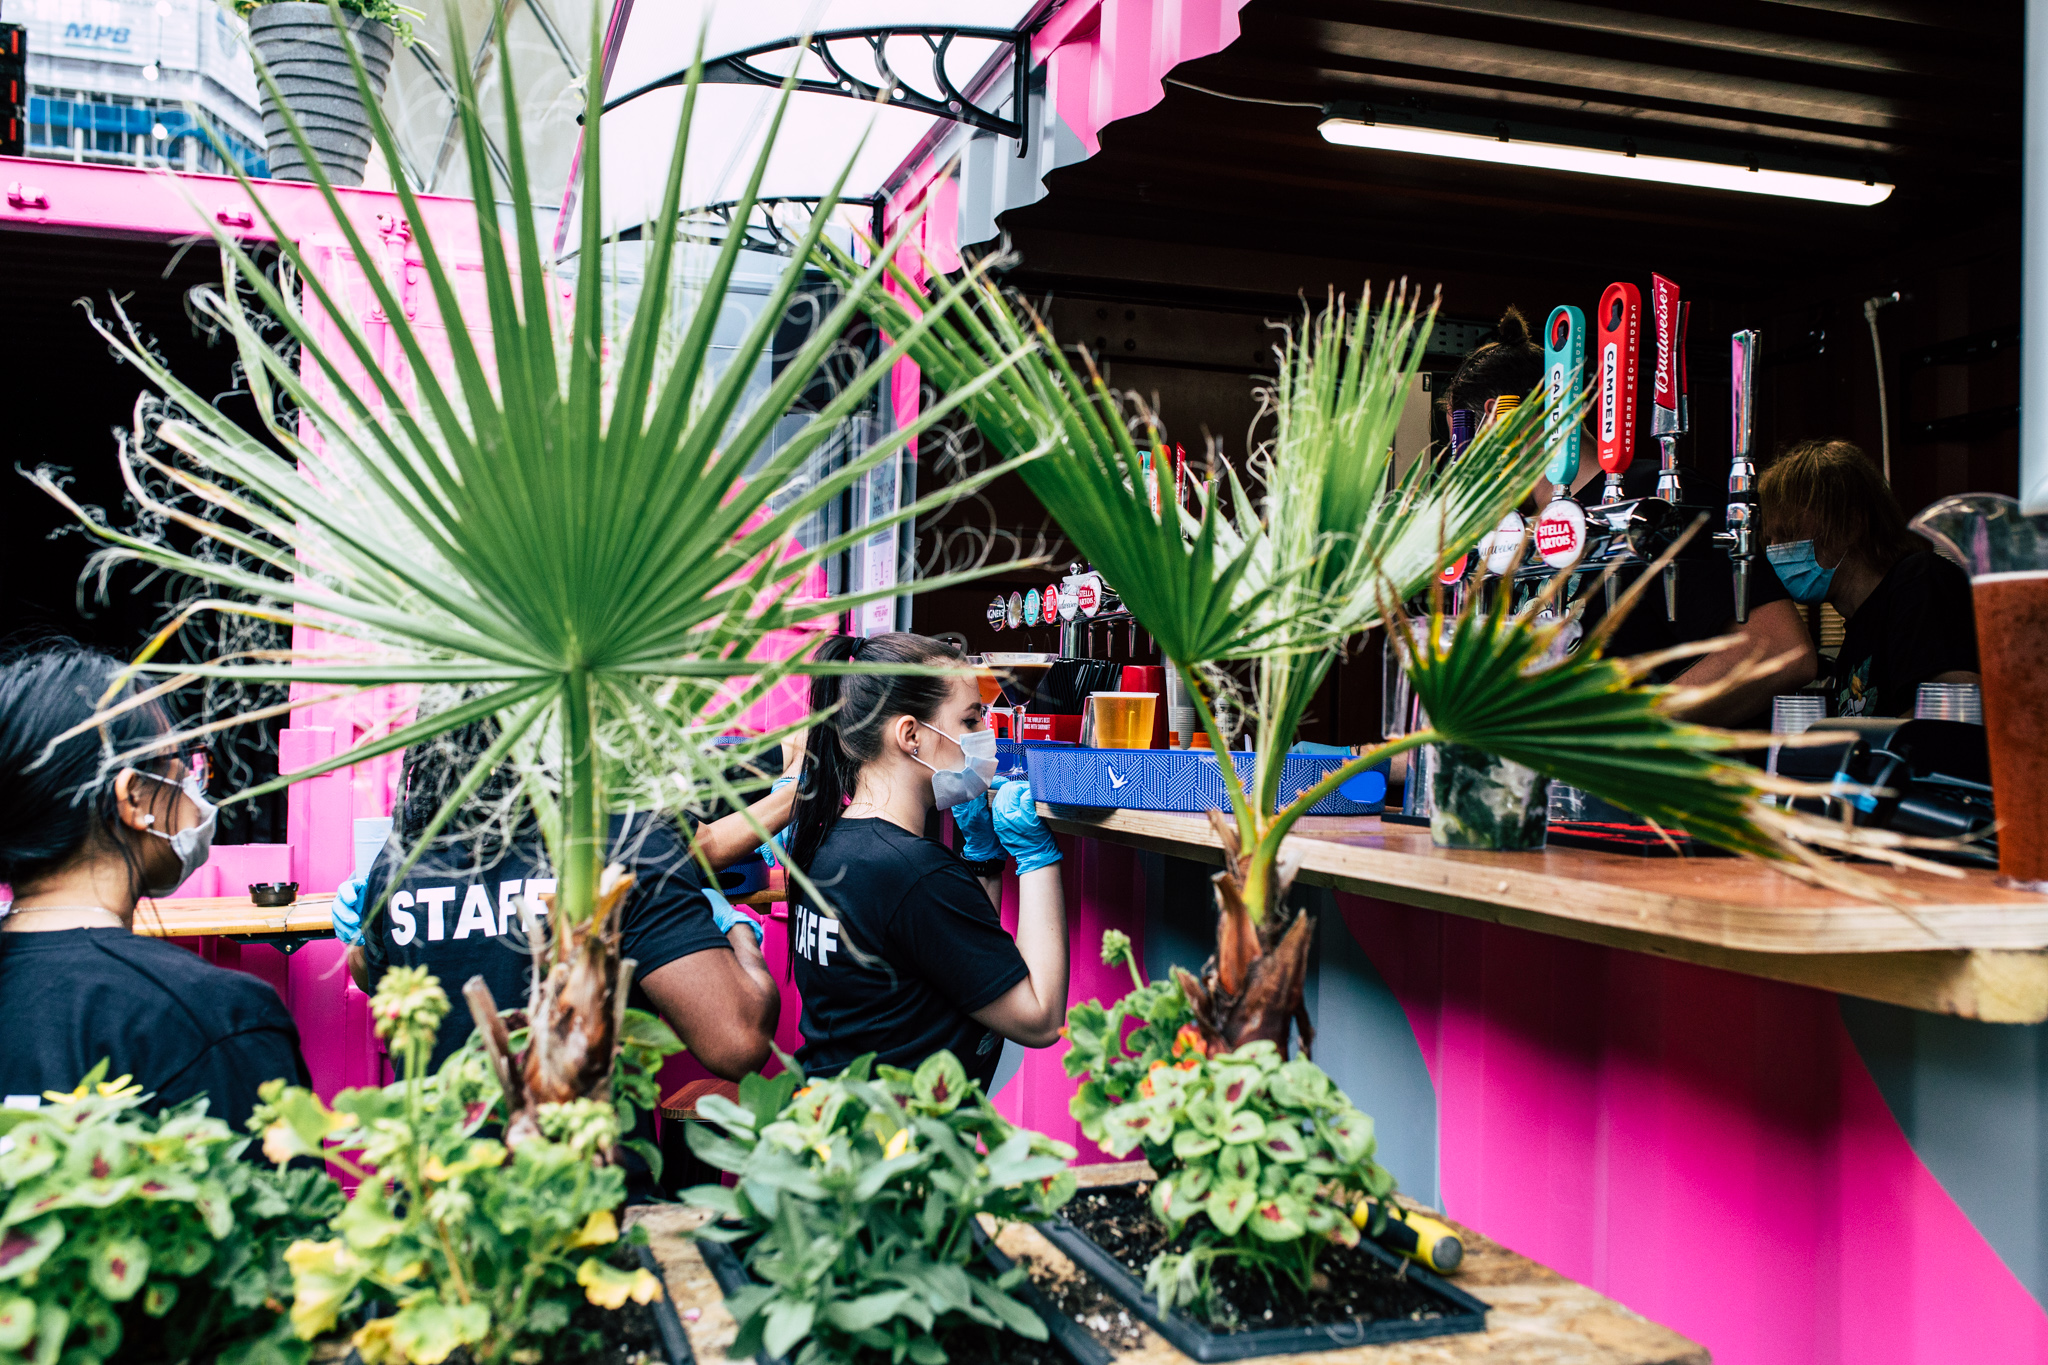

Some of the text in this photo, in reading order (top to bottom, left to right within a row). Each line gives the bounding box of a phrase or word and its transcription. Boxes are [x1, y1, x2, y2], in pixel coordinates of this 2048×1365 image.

[65, 22, 131, 44] MPB
[1653, 281, 1669, 400] Budweiser
[1605, 350, 1614, 434] CAMDEN
[1625, 305, 1637, 453] CAMDEN TOWN BREWERY
[1569, 411, 1578, 466] BEWERY
[1539, 523, 1570, 537] STELLA
[1540, 535, 1571, 550] ARTOIS
[390, 878, 558, 947] STAFF
[795, 904, 840, 967] TAFF
